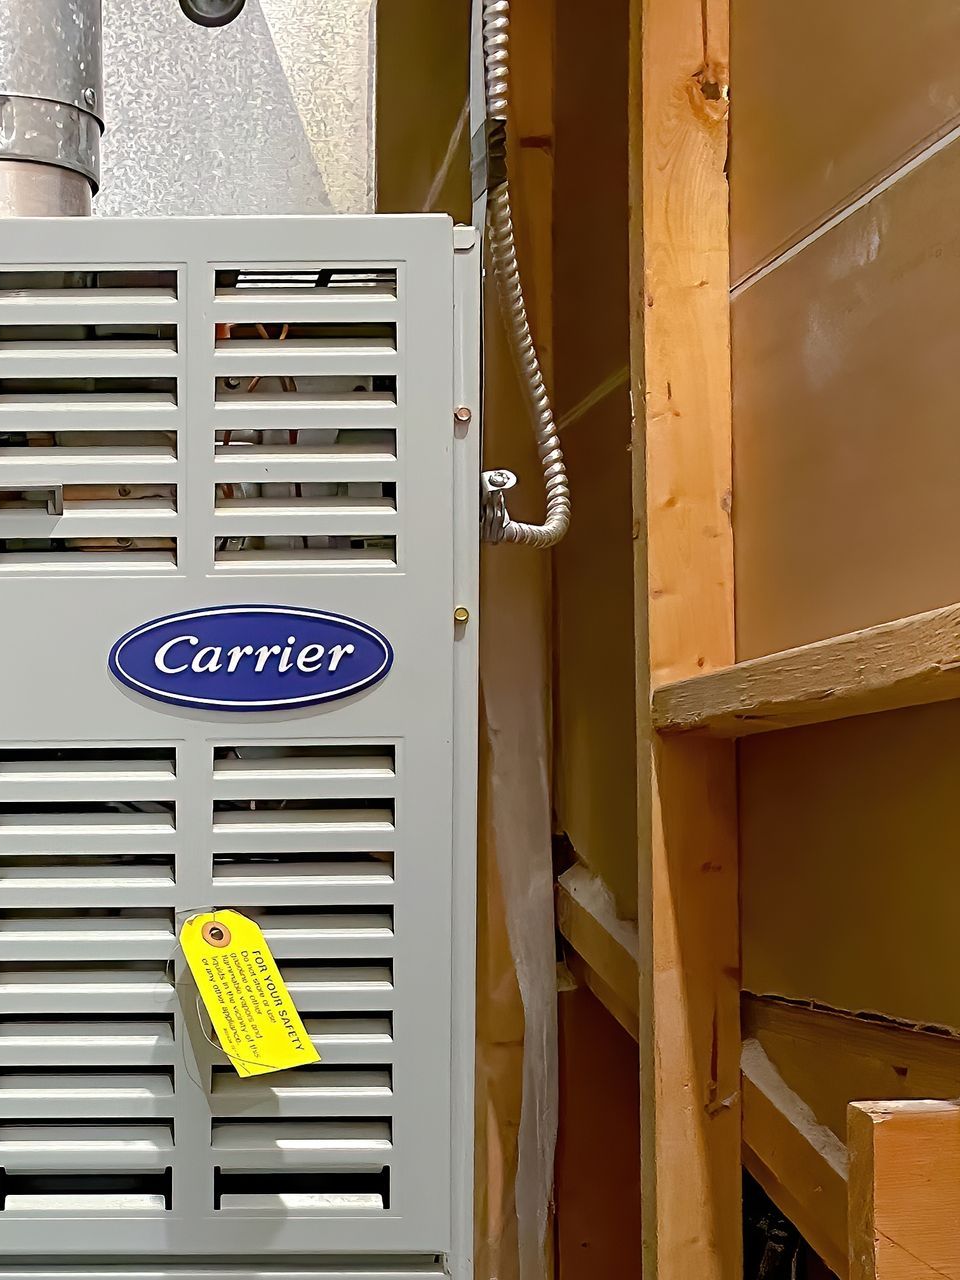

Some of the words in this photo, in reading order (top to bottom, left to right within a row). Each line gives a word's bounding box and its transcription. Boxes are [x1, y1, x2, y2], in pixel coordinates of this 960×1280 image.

[154, 635, 355, 674] Carrier
[252, 950, 268, 972] FOR
[264, 975, 283, 1006] YOUR
[278, 1010, 304, 1051] SAFETY
